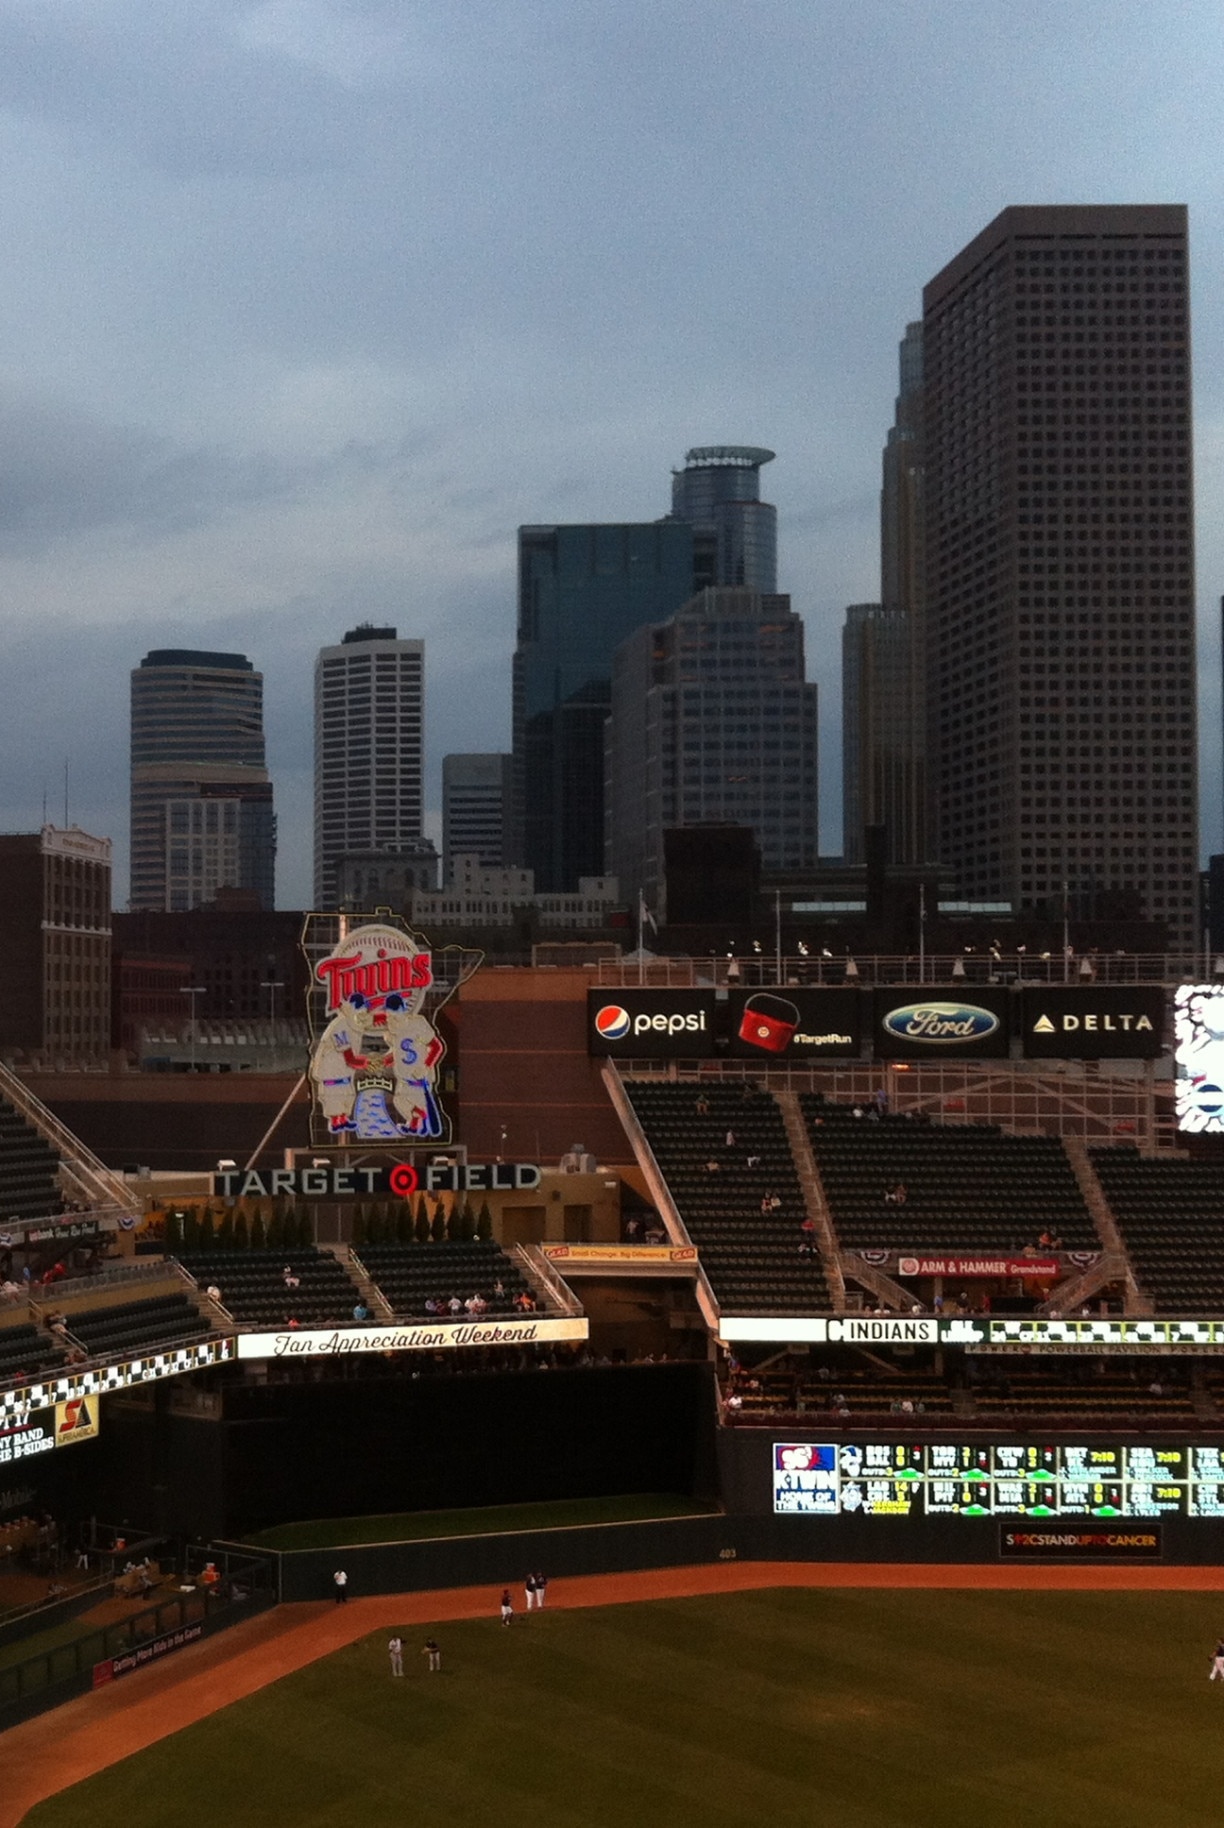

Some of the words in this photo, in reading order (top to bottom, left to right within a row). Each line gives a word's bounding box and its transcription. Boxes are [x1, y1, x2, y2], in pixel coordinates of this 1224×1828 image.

[316, 949, 432, 1012] Twins
[634, 1010, 707, 1036] pepsi
[905, 1010, 976, 1036] Ford
[1063, 1014, 1154, 1031] DELTA
[333, 1031, 349, 1048] M
[793, 1034, 852, 1045] #TargetRun
[400, 1038, 417, 1064] S
[216, 1167, 382, 1195] TARGET
[427, 1164, 541, 1190] FIELD
[546, 1247, 569, 1259] GLAD
[670, 1249, 695, 1260] GLAD
[921, 1261, 945, 1273] ARM
[948, 1261, 956, 1273] &
[960, 1262, 1006, 1273] HAMMER
[1010, 1264, 1056, 1274] Grandstand
[850, 1322, 929, 1340] INDIANS
[274, 1335, 313, 1357] Fan
[318, 1331, 446, 1357] Appreciation
[450, 1324, 537, 1345] Weekend
[15, 1412, 30, 1427] 17
[14, 1428, 43, 1445] BAND
[14, 1437, 54, 1459] B-SIDES
[895, 1481, 907, 1491] 14
[780, 1491, 814, 1501] HOME
[719, 1549, 736, 1559] 403
